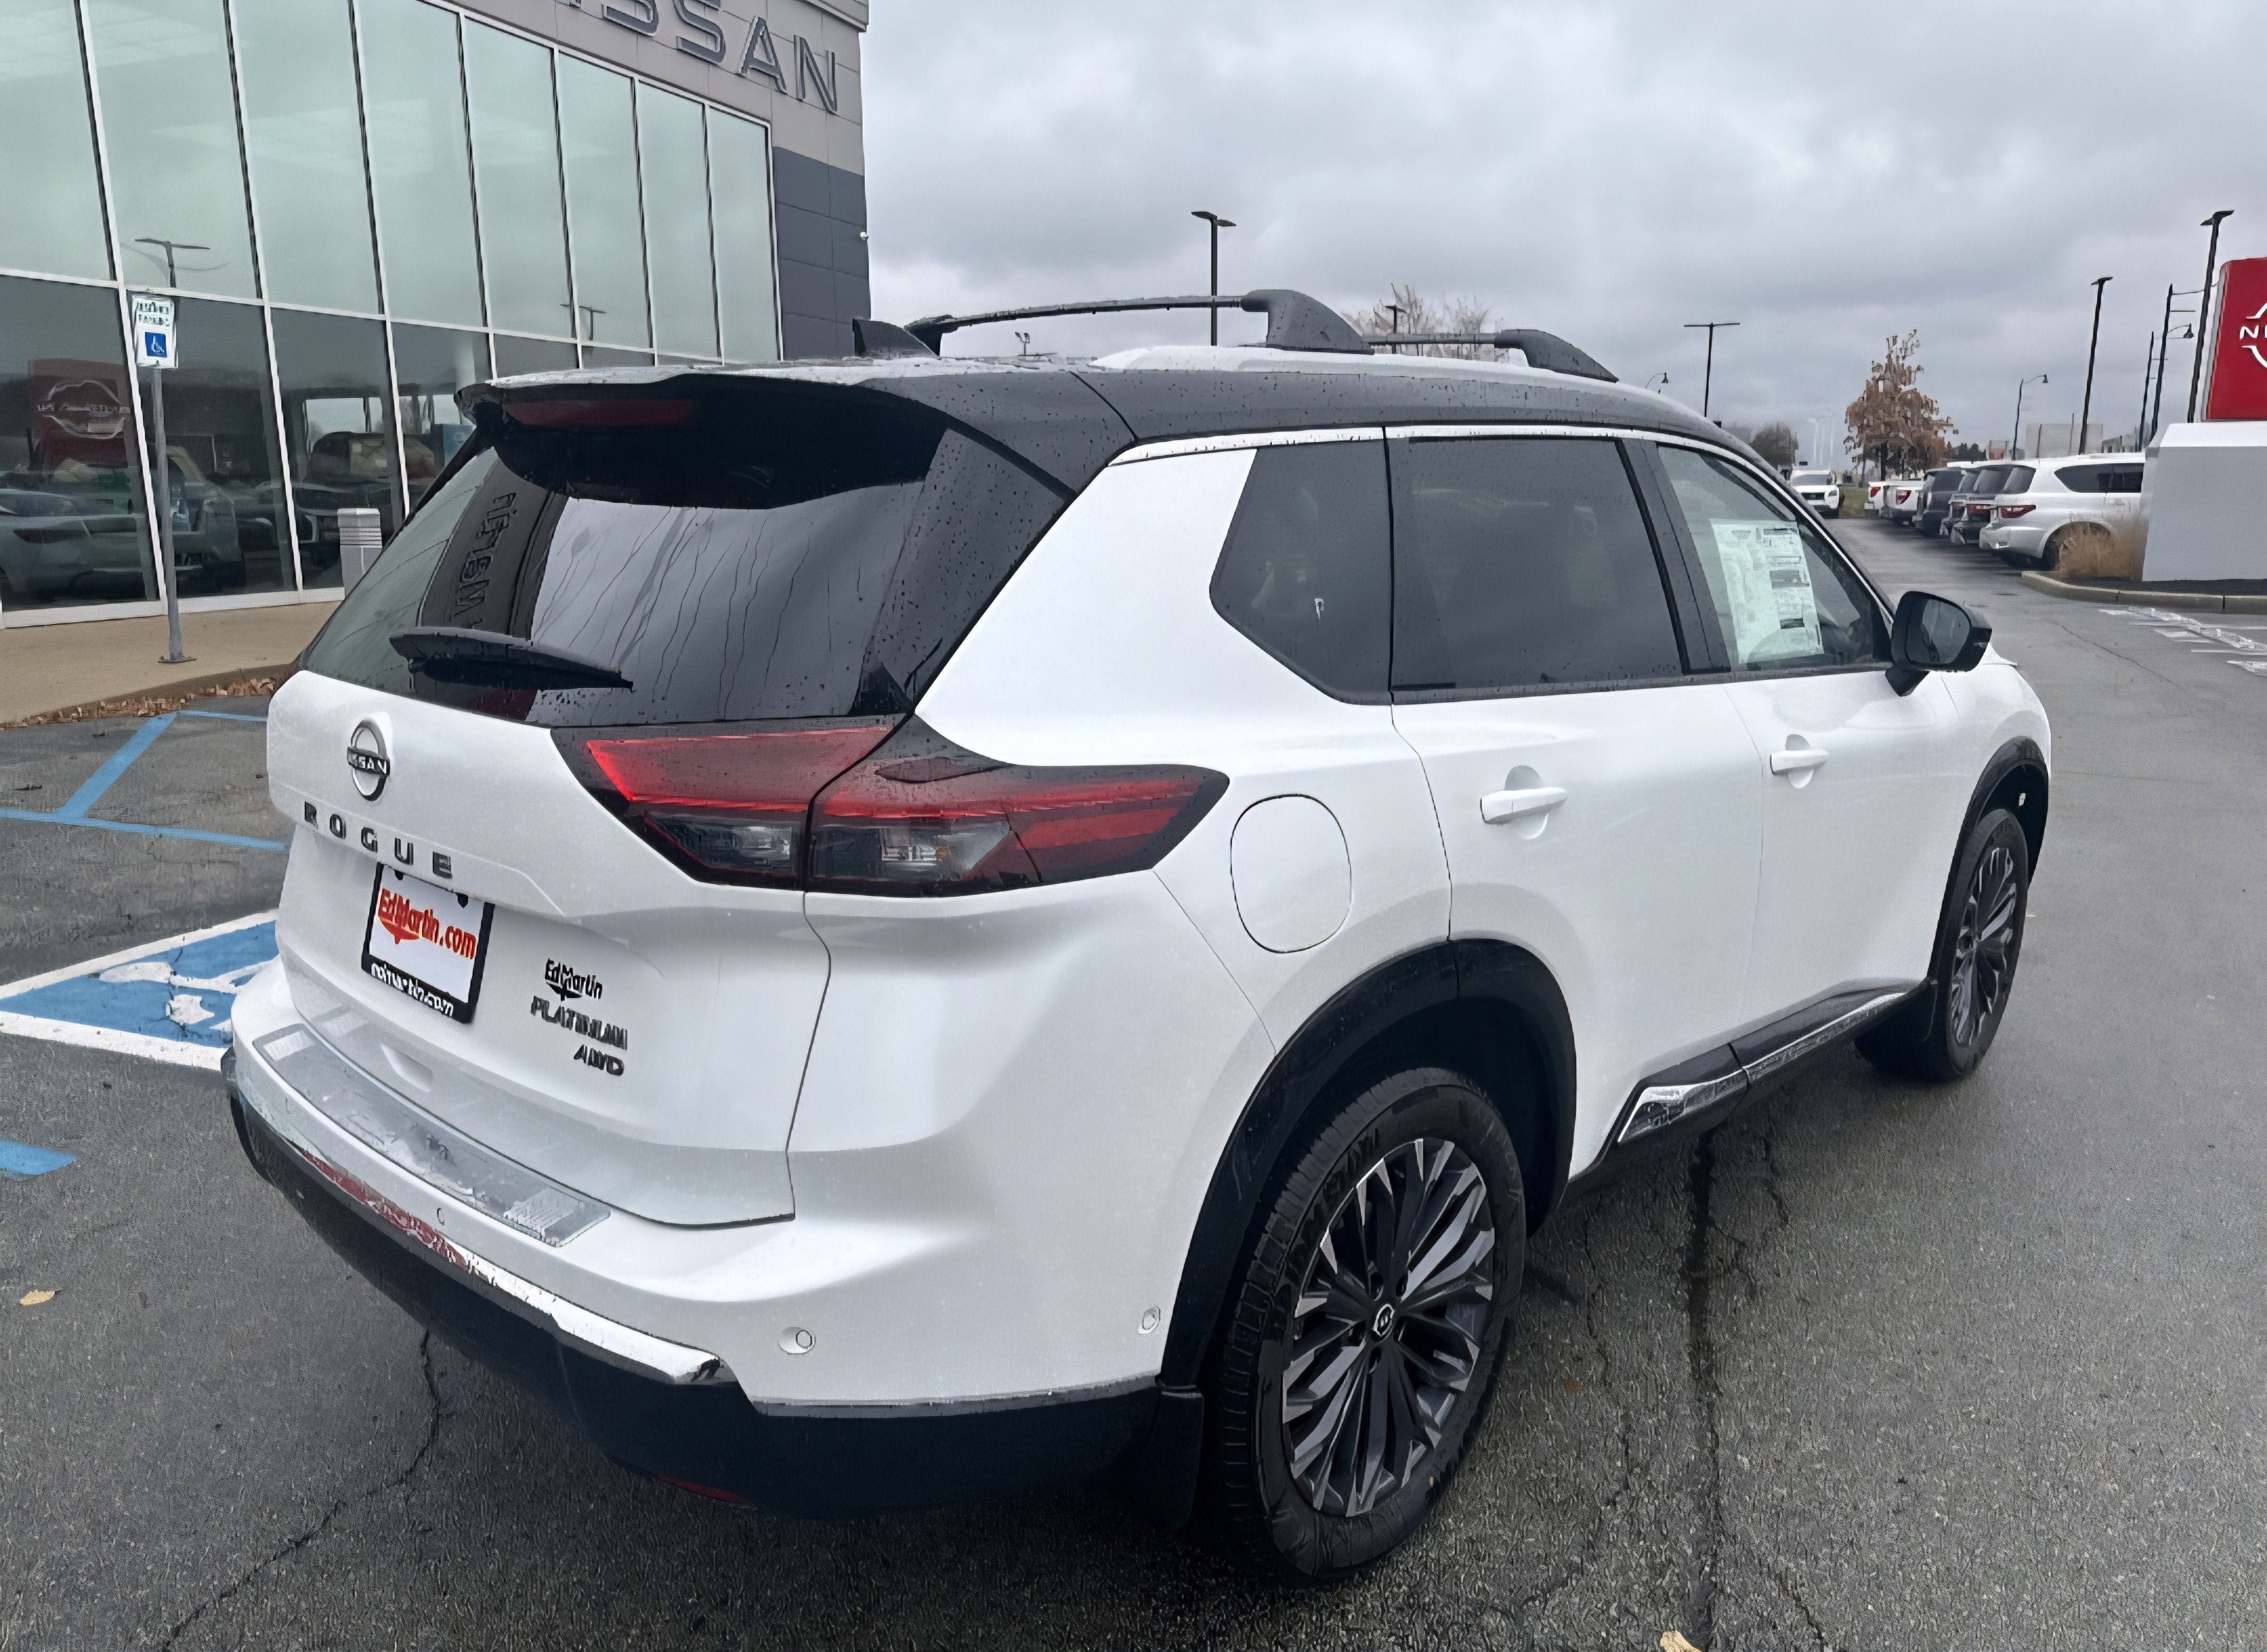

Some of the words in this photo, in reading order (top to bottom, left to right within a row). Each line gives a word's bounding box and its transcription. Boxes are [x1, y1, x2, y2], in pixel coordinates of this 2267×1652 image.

[569, 0, 838, 113] SAN
[304, 801, 452, 878] ROGUE
[573, 1044, 624, 1076] AWD
